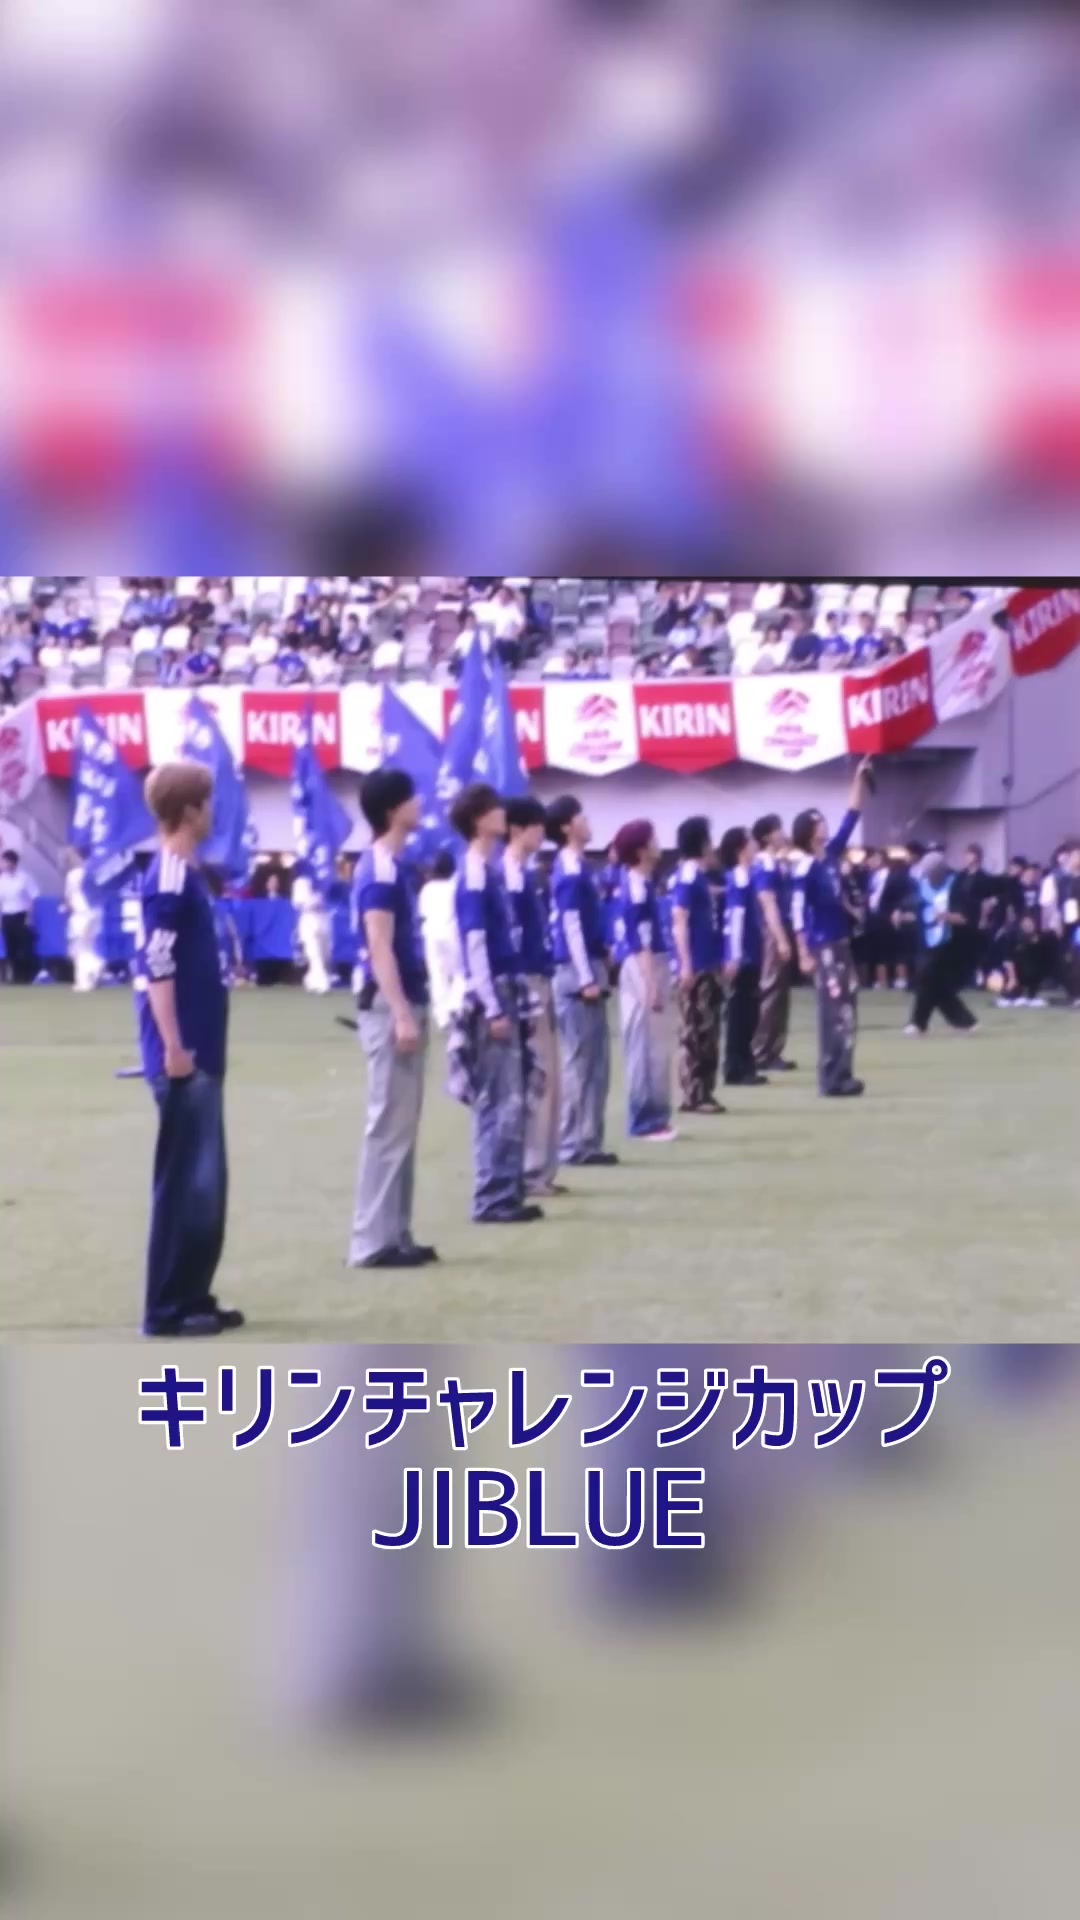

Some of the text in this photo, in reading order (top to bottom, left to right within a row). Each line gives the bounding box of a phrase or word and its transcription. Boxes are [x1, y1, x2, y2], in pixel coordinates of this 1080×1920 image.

[638, 702, 731, 738] KIRIN
[848, 675, 928, 729] KIRIN
[46, 713, 143, 752] KIIN
[246, 711, 337, 746] KIRN
